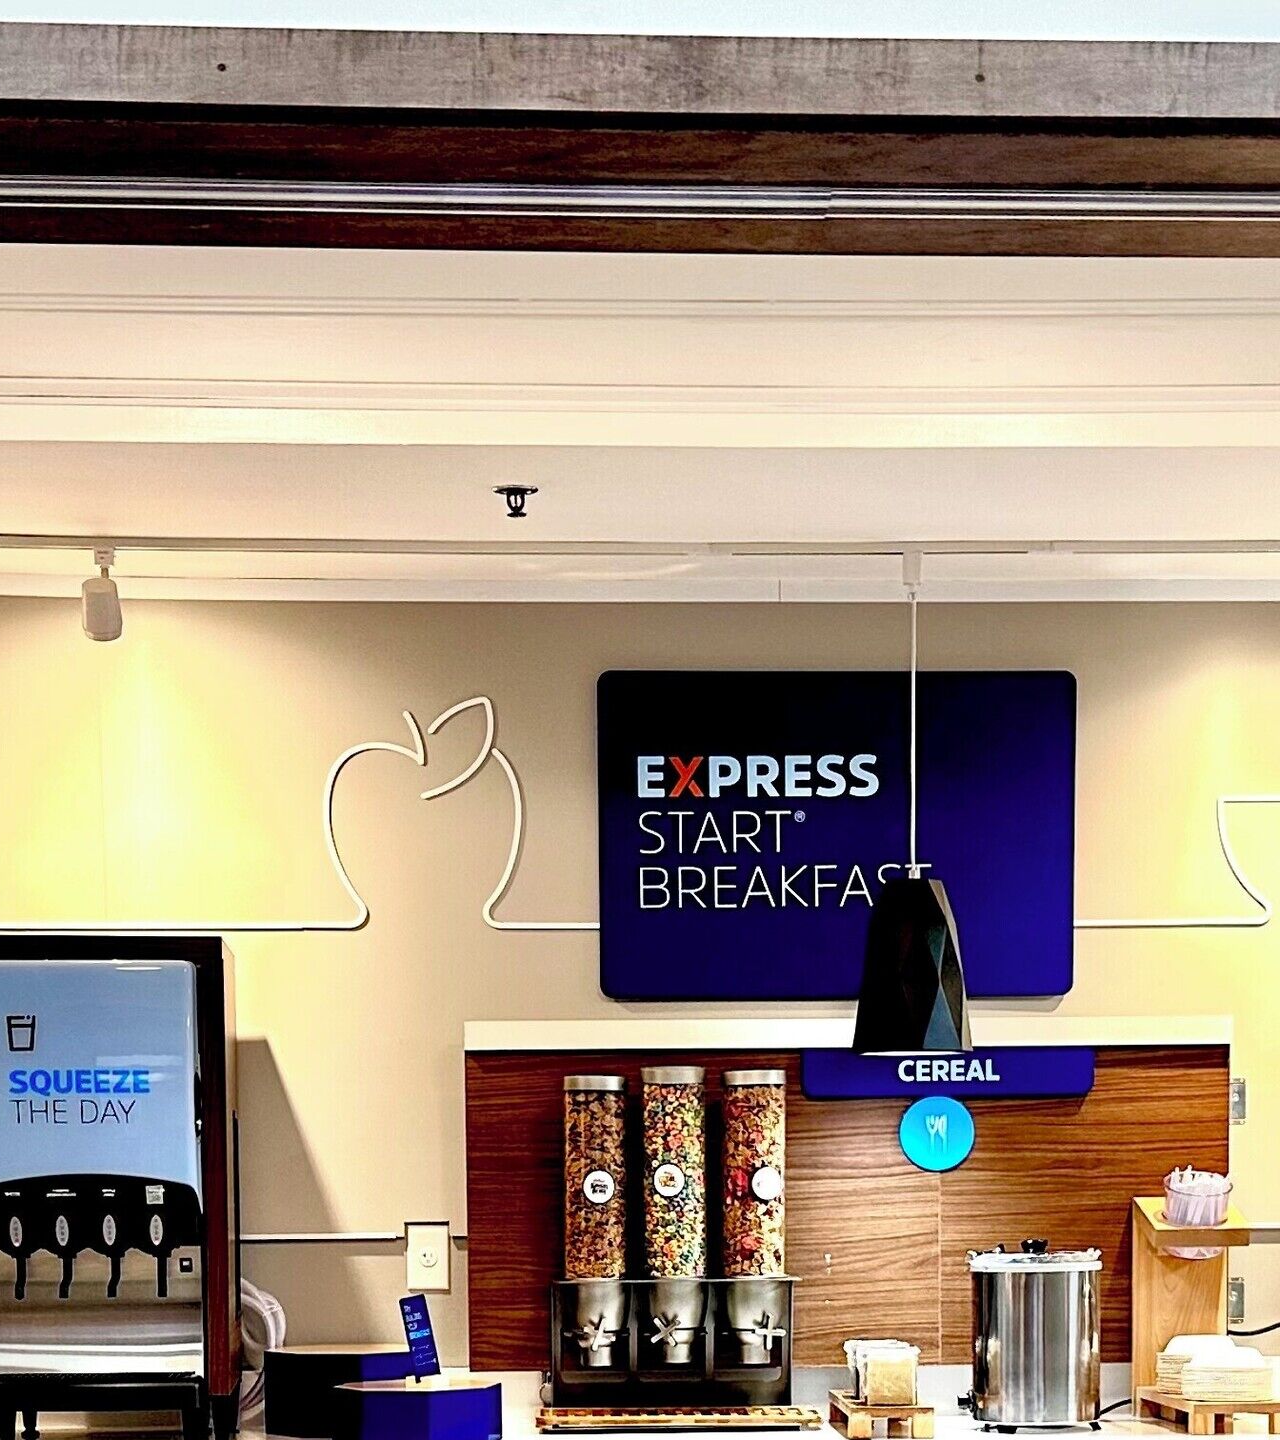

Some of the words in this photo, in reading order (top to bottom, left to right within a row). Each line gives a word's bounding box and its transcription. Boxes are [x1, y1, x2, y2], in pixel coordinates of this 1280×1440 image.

[637, 754, 879, 798] EXPRESS
[8, 1069, 150, 1096] SQUEEZE
[897, 1059, 1000, 1081] CEREAL
[8, 1099, 68, 1123] THE
[79, 1099, 136, 1123] DAY
